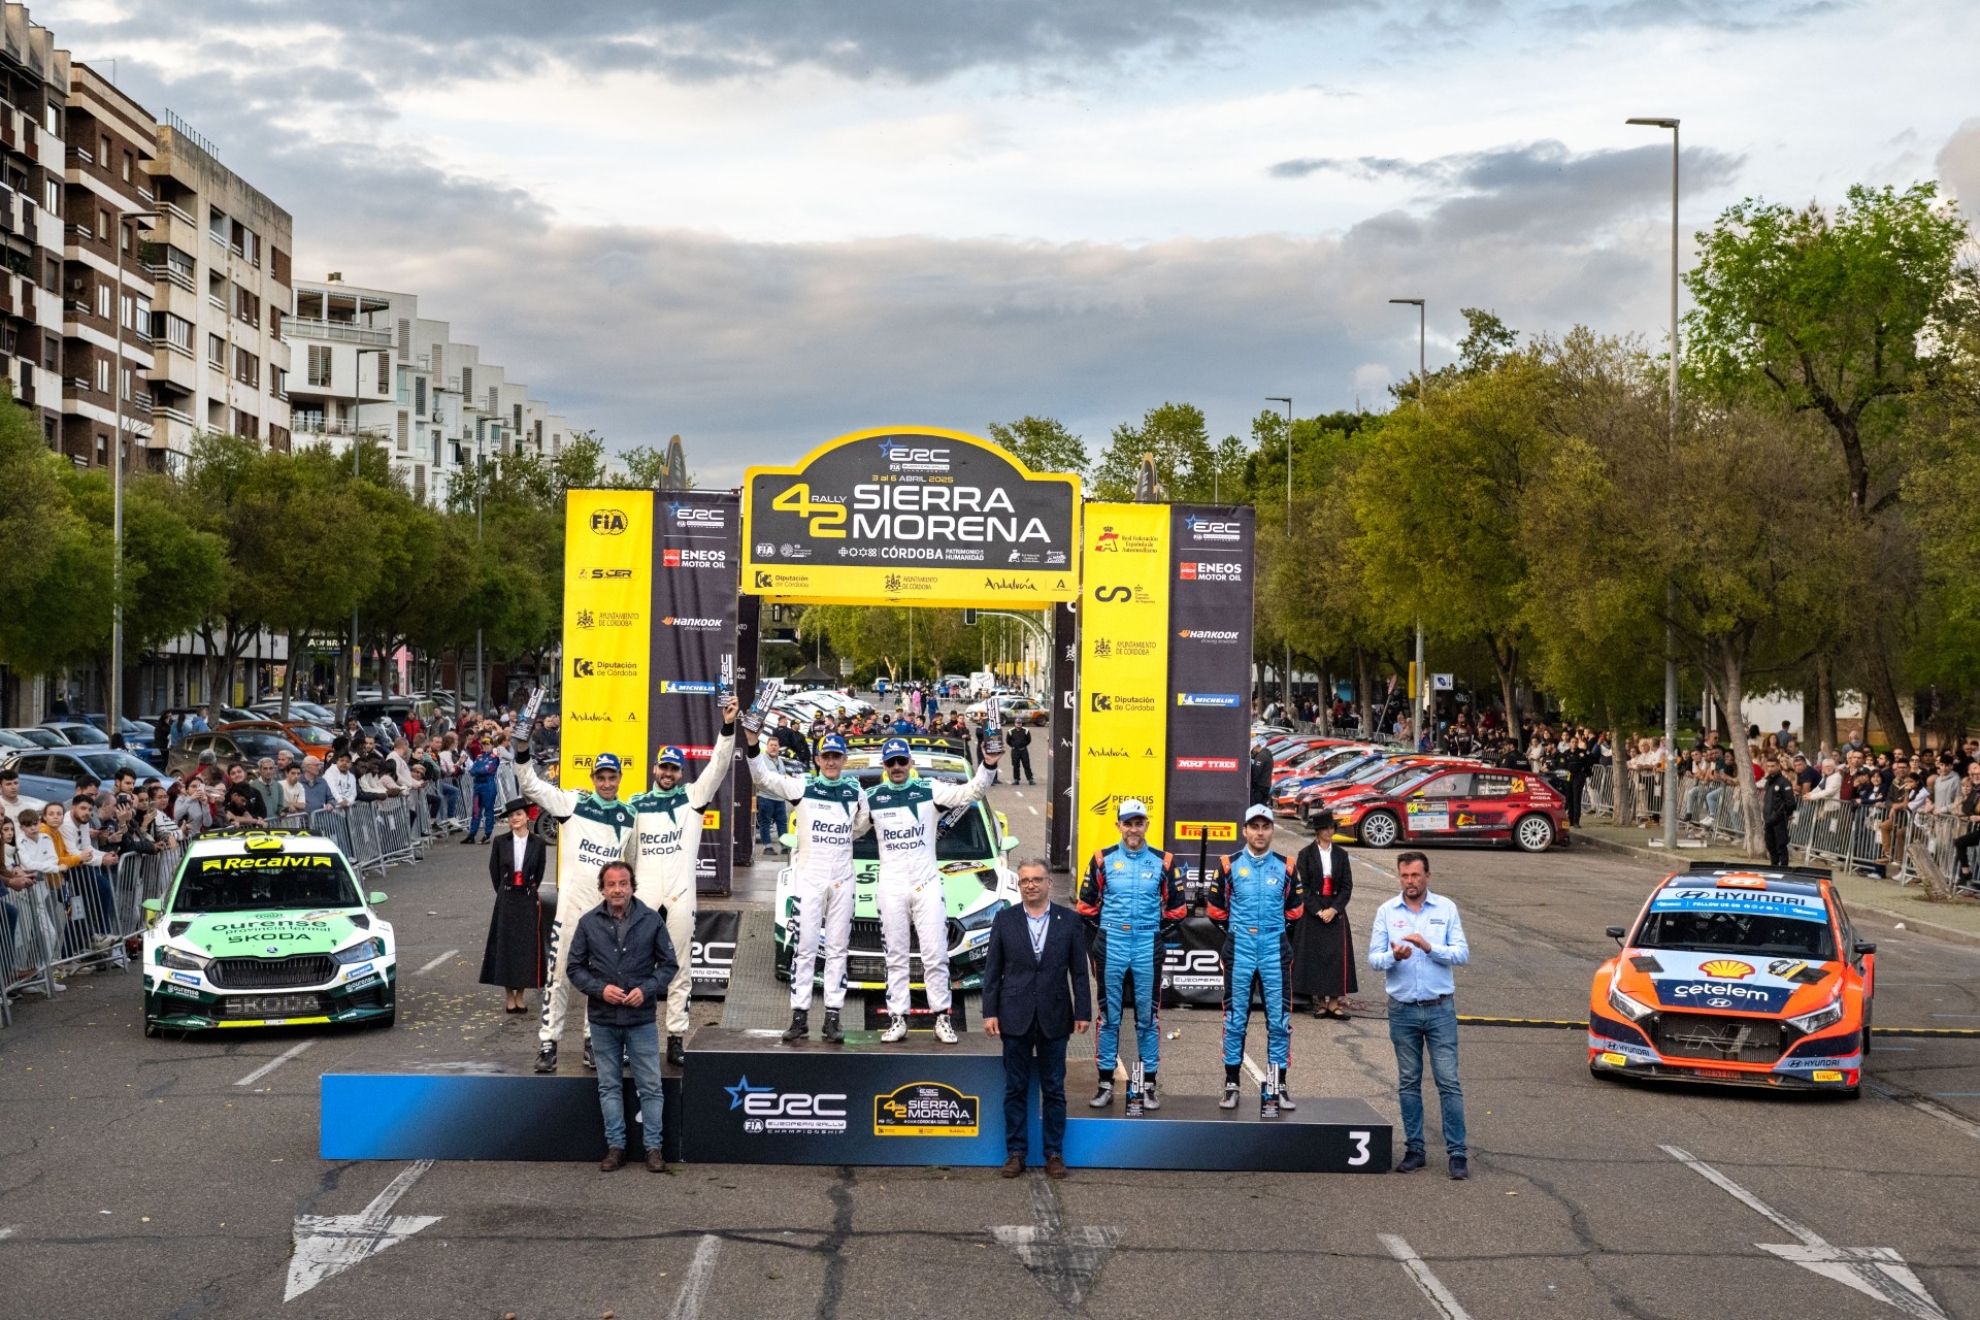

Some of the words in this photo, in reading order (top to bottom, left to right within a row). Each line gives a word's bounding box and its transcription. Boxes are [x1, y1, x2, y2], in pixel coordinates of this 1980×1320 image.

[889, 448, 951, 462] ERC
[899, 475, 927, 483] ABRIL
[928, 475, 954, 483] 2025
[811, 494, 848, 503] RALLY
[853, 483, 1015, 513] SIERRA
[677, 509, 724, 520] ERC
[853, 514, 1051, 543] MORENA
[1193, 522, 1241, 533] ERC
[681, 550, 726, 561] ENEOS
[881, 545, 944, 560] CÓRDOBA
[712, 561, 725, 569] OIL
[1198, 563, 1242, 573] ENEOS
[984, 577, 1038, 591] Andalucía
[599, 612, 639, 620] AYUNTAMIENTO
[607, 619, 632, 627] CÓRDOBA
[1116, 641, 1156, 649] AYUNTAMIENTO
[1124, 647, 1150, 655] CÓRDOBA
[597, 661, 637, 669] Diputación
[607, 669, 637, 677] Córdoba
[1114, 695, 1155, 704] Diputación
[1125, 704, 1155, 712] Córdoba
[570, 711, 613, 723] Andalucía
[1087, 747, 1131, 758] Andalucía
[1178, 760, 1206, 768] MRF
[1208, 760, 1236, 768] TYRES
[1511, 780, 1525, 793] 23
[812, 820, 853, 834] Recalvi
[883, 824, 925, 841] Recalvi
[640, 827, 683, 844] Recalvi
[812, 835, 851, 845] SKODA
[579, 838, 622, 858] Recalvi
[641, 844, 683, 856] SKODA
[885, 839, 926, 851] SKODA
[223, 855, 311, 870] Recalvi
[1715, 891, 1806, 906] HYUNDAI
[211, 919, 327, 932] ourense
[225, 925, 287, 935] provincia
[1162, 949, 1220, 972] ER
[351, 975, 376, 989] ourense
[173, 985, 199, 996] ourense
[1674, 983, 1769, 1001] cetelem
[1618, 1044, 1650, 1056] HYUNDAI
[1803, 1059, 1841, 1067] HYUNDAI
[744, 1093, 847, 1116] ERC
[908, 1100, 959, 1109] SIERRA
[908, 1109, 970, 1118] MORENA
[744, 1120, 764, 1132] FIA
[1347, 1131, 1371, 1166] 3
